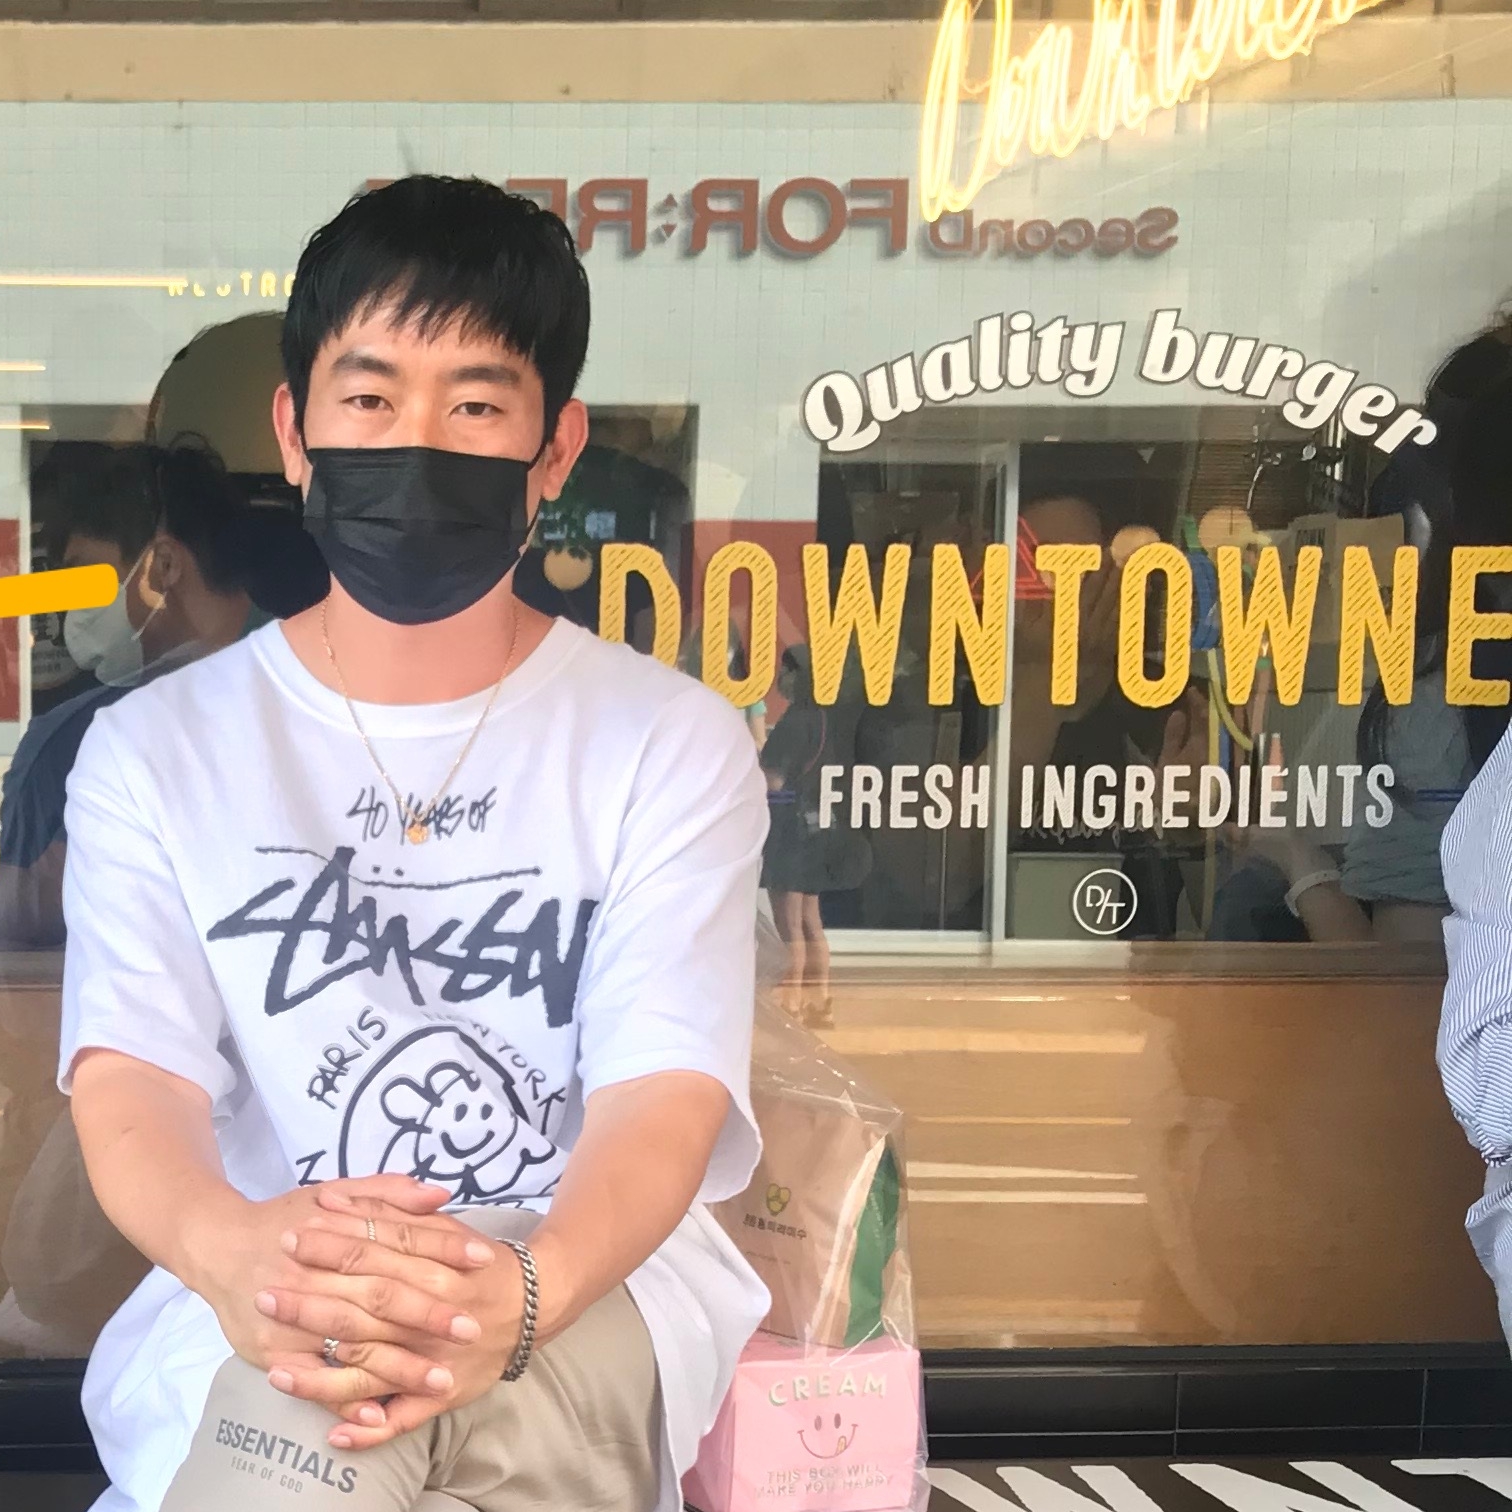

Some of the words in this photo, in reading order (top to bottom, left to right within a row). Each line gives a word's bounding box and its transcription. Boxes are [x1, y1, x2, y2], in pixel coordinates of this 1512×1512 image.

[802, 310, 1126, 453] Quality
[1139, 308, 1439, 454] burger
[345, 785, 389, 842] 40
[819, 764, 991, 829] FRESH
[1020, 763, 1397, 829] INGREDIENTS
[306, 1005, 388, 1110] PARIS
[769, 1372, 887, 1406] CREAM
[216, 1418, 357, 1494] ESSENTIALS
[260, 1466, 275, 1481] OF
